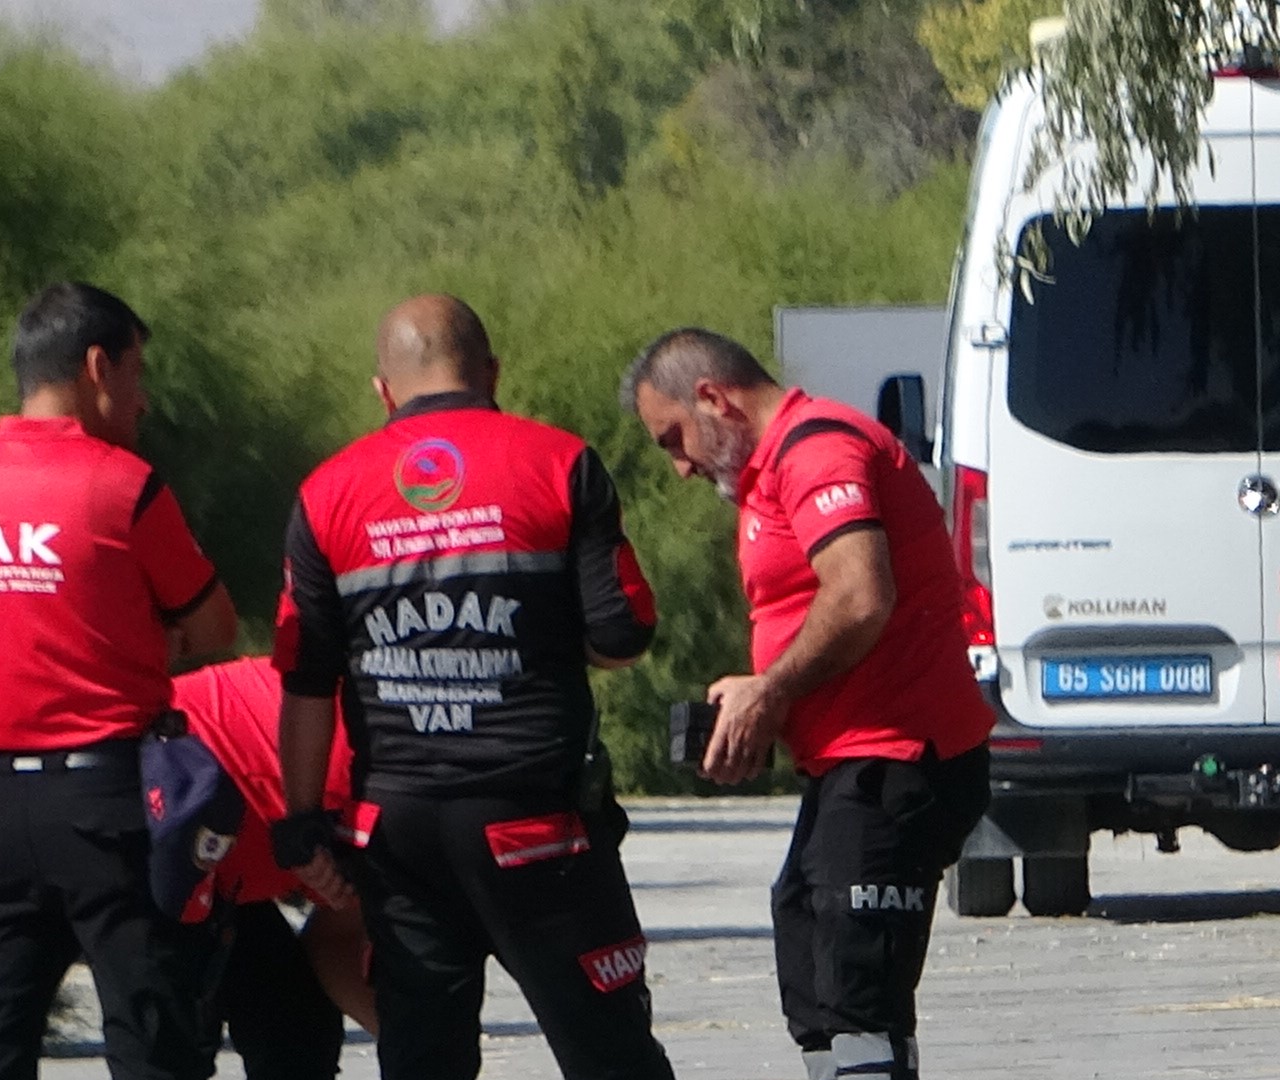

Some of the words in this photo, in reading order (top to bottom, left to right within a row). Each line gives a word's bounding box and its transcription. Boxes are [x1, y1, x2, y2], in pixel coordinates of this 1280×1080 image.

[365, 591, 521, 646] HADAK
[1068, 599, 1167, 616] KOLUMAN
[1058, 664, 1088, 692] 65
[1100, 663, 1146, 692] SGH
[407, 704, 473, 734] VAN
[850, 884, 924, 911] HAK
[593, 944, 644, 984] HAD
